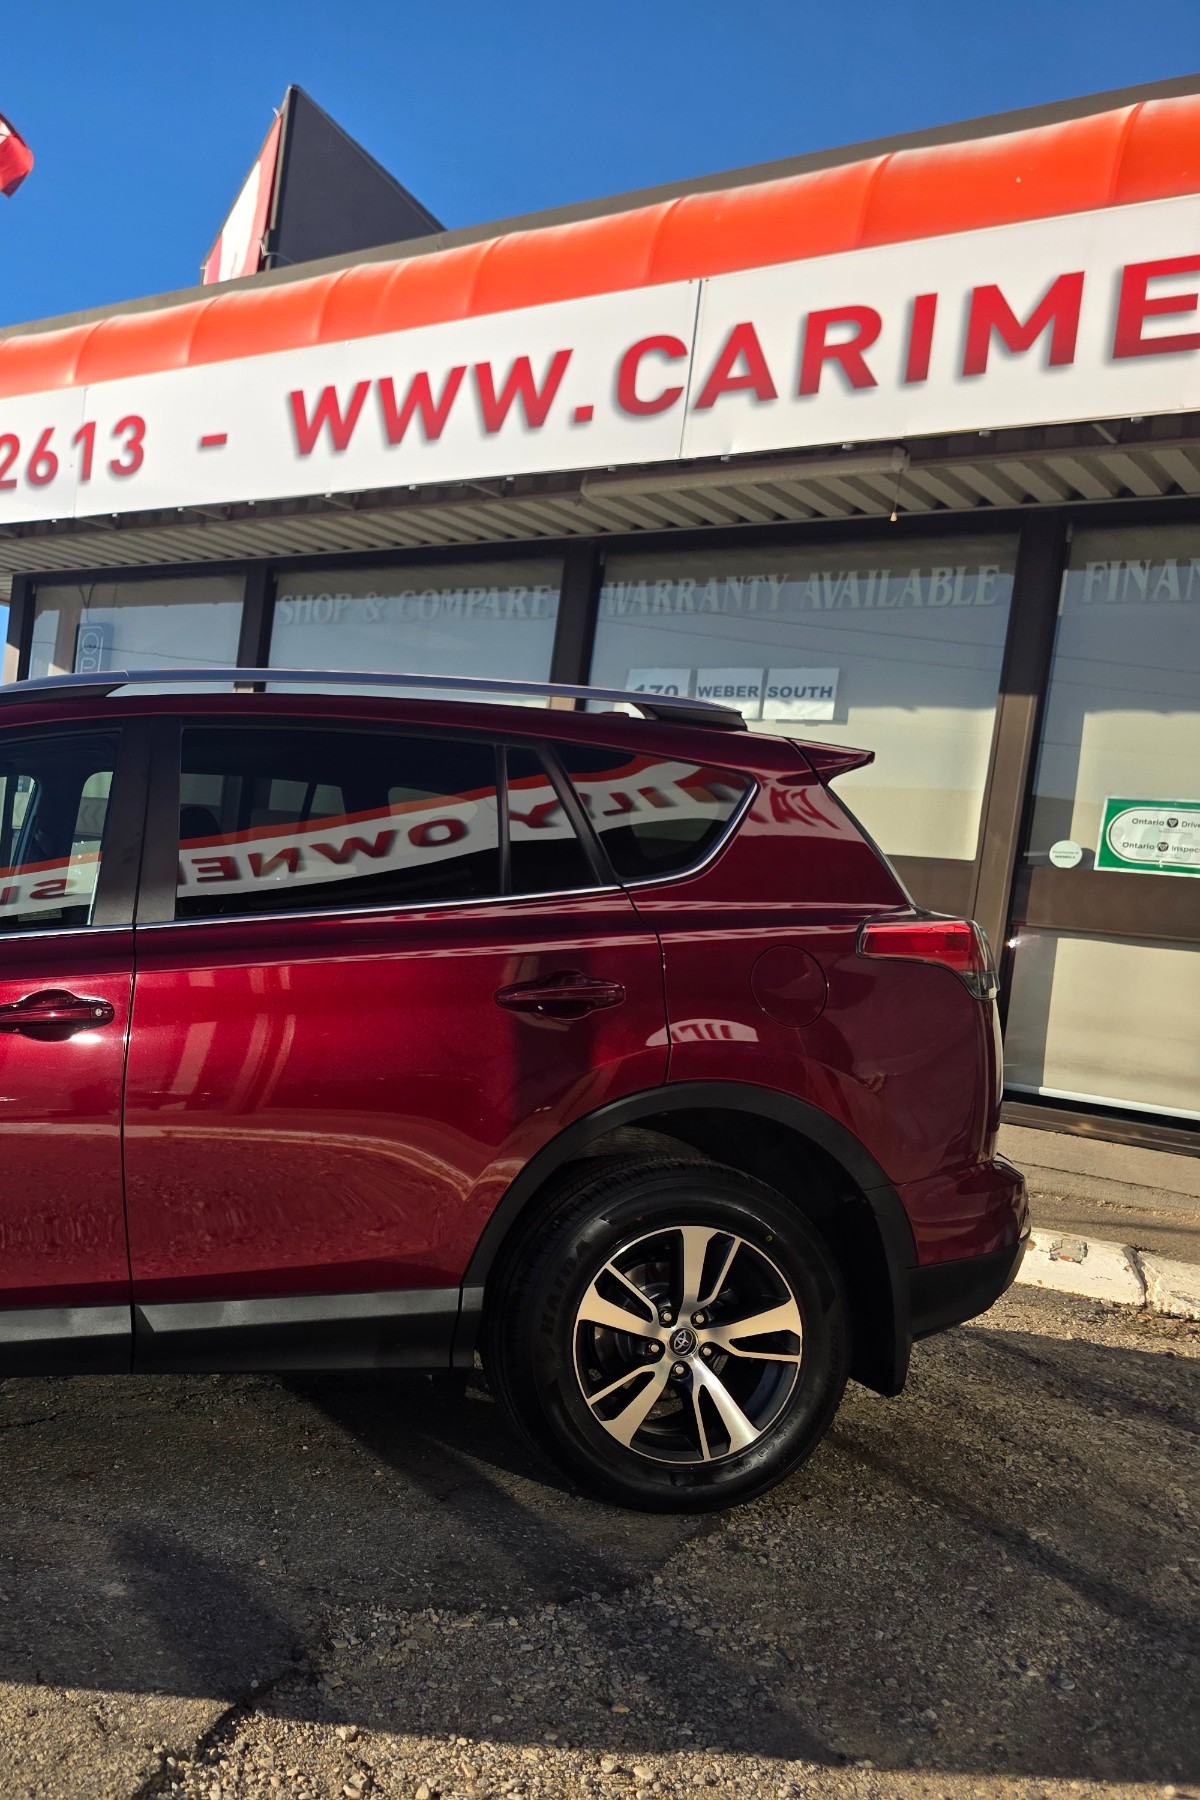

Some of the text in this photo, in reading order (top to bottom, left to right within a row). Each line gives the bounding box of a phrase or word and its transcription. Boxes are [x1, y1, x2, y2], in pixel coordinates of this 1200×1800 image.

[605, 563, 1000, 616] WARRANTY AVAILABLE
[279, 585, 554, 625] SHOP & COMPARE
[698, 685, 759, 698] WEBER
[767, 686, 833, 698] SOUTH
[1132, 818, 1165, 827] Ontario
[1122, 841, 1200, 853] Ontario Inspec
